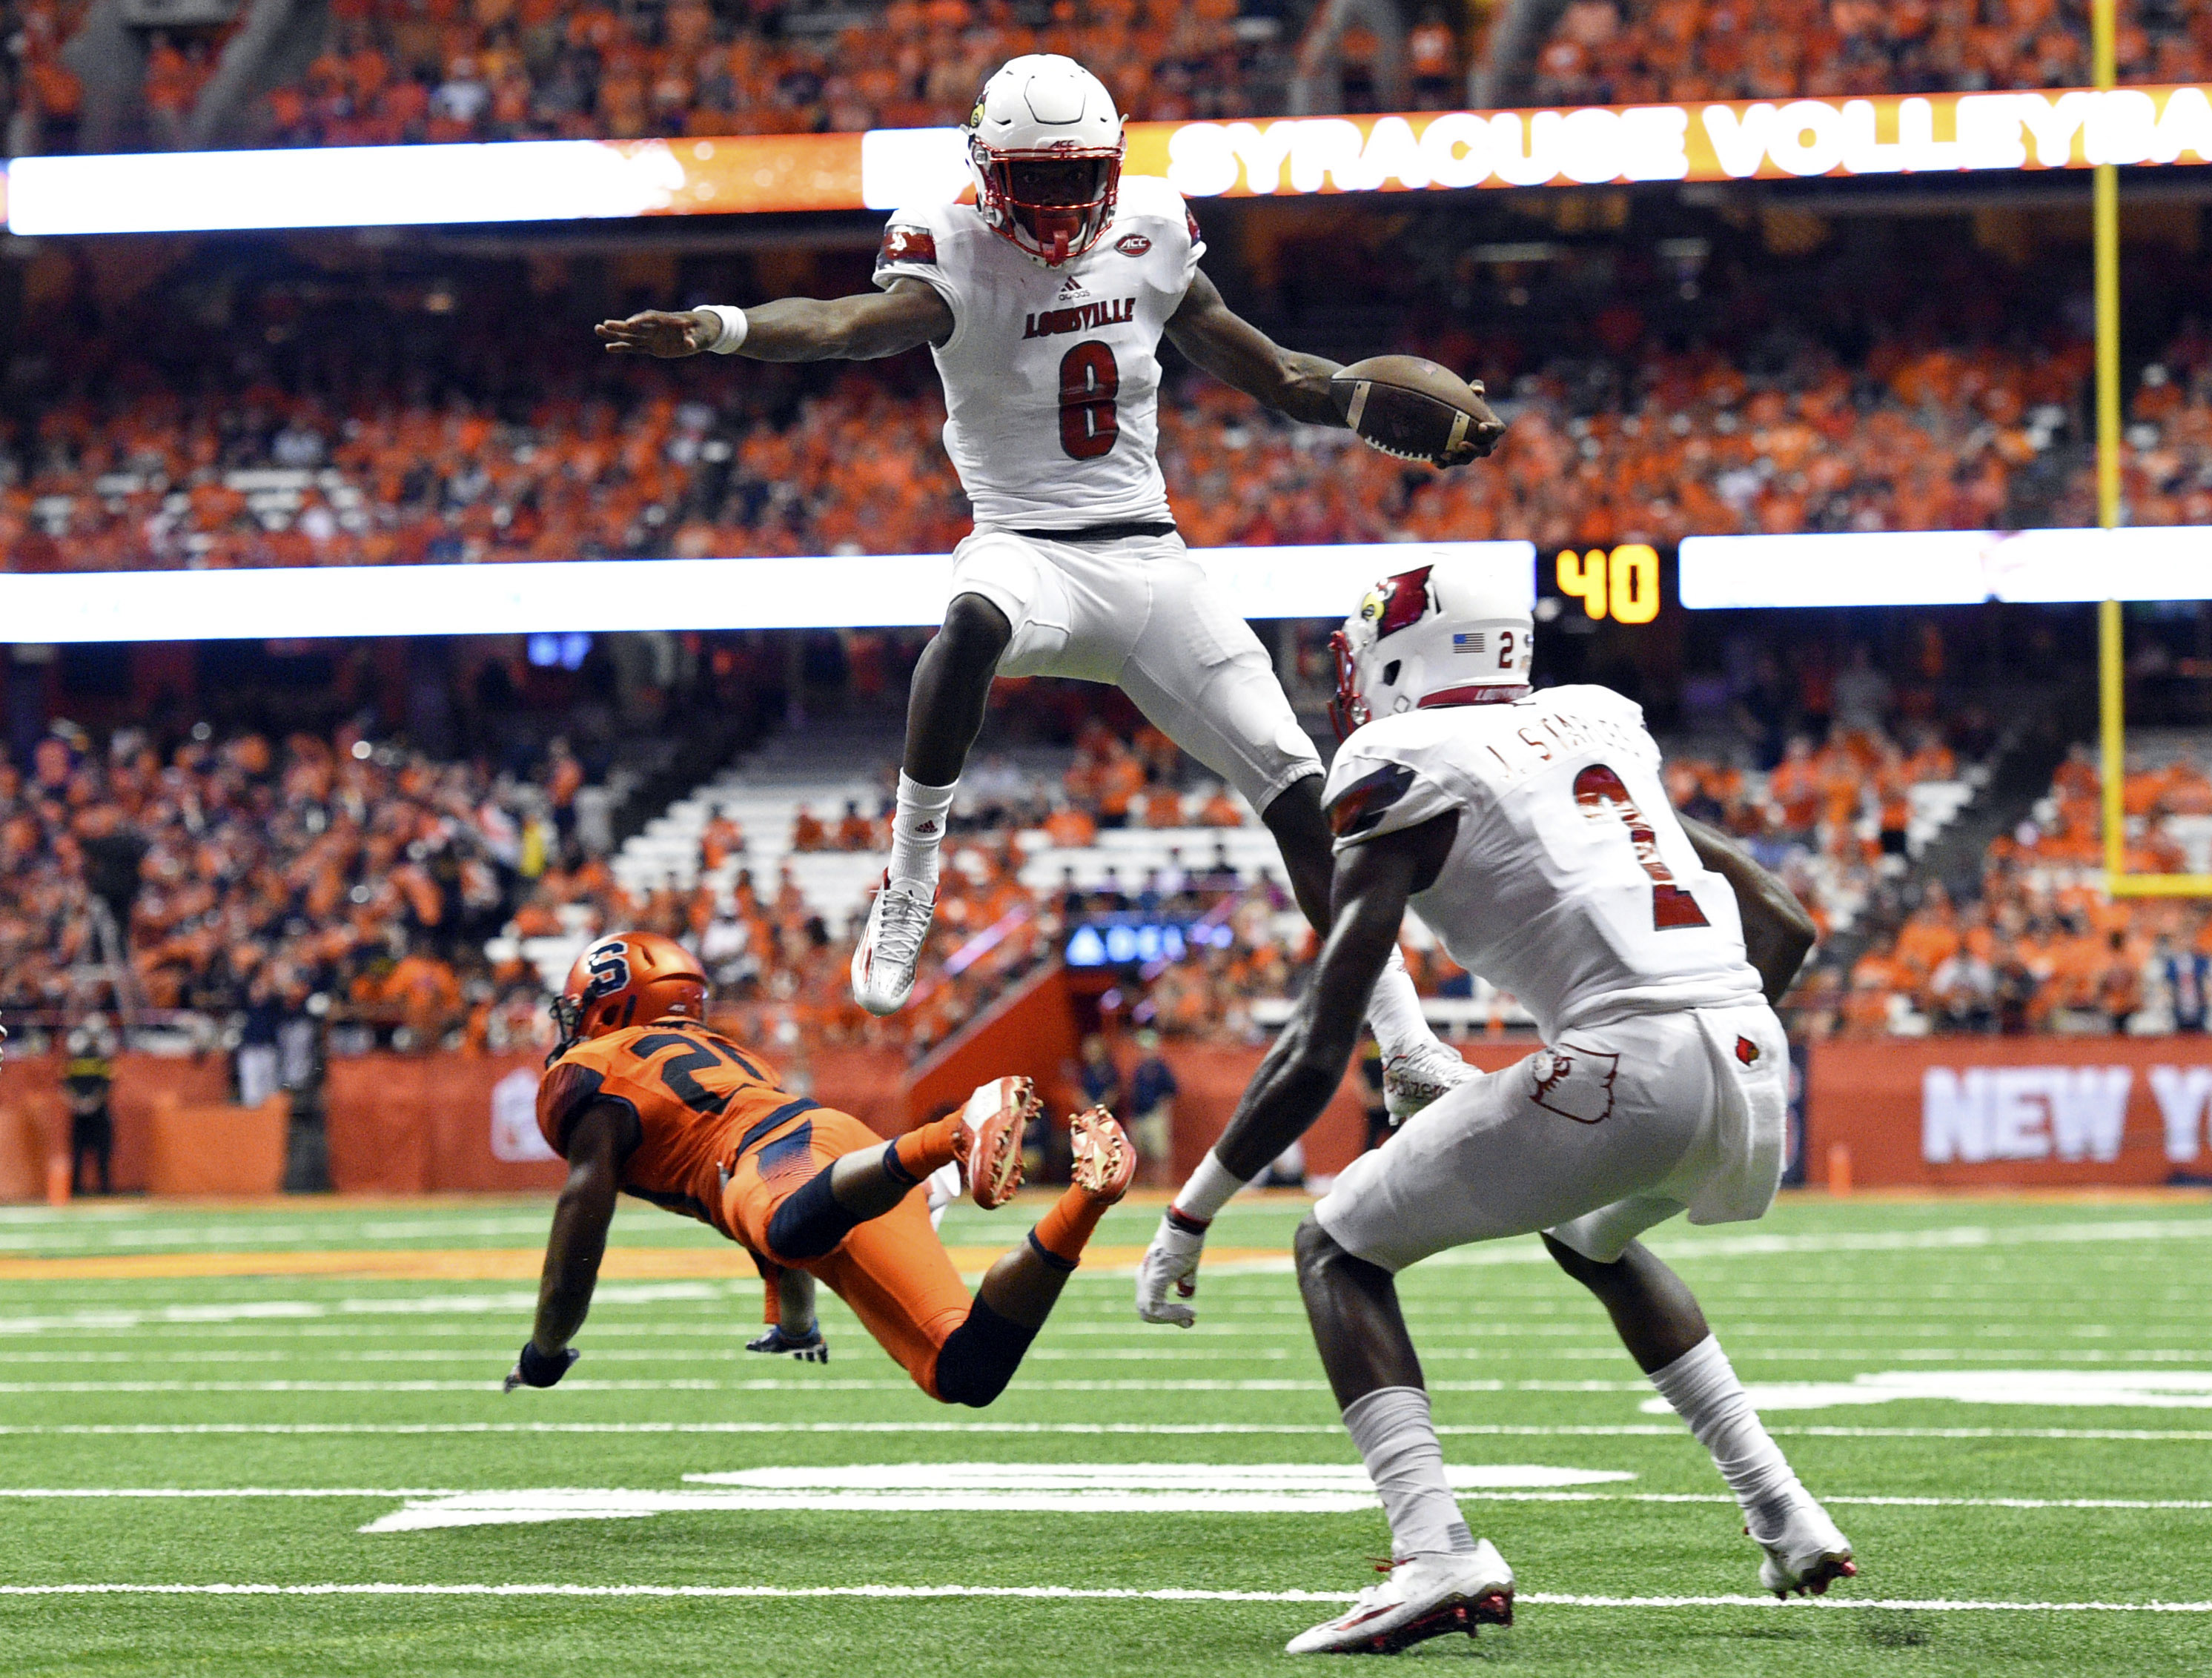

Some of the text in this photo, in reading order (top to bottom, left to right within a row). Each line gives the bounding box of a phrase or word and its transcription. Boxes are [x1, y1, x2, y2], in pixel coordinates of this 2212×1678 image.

[1168, 107, 1688, 196] SYRACUSE
[1119, 237, 1149, 249] ACC
[1022, 298, 1136, 339] LOUISVILLE
[1059, 290, 1090, 301] addas
[1059, 339, 1119, 461] 8
[1556, 543, 1660, 624] 40
[1498, 631, 1514, 669] 2
[1572, 763, 1711, 932] 2
[589, 940, 631, 998] S
[1922, 1065, 2131, 1164] NEW
